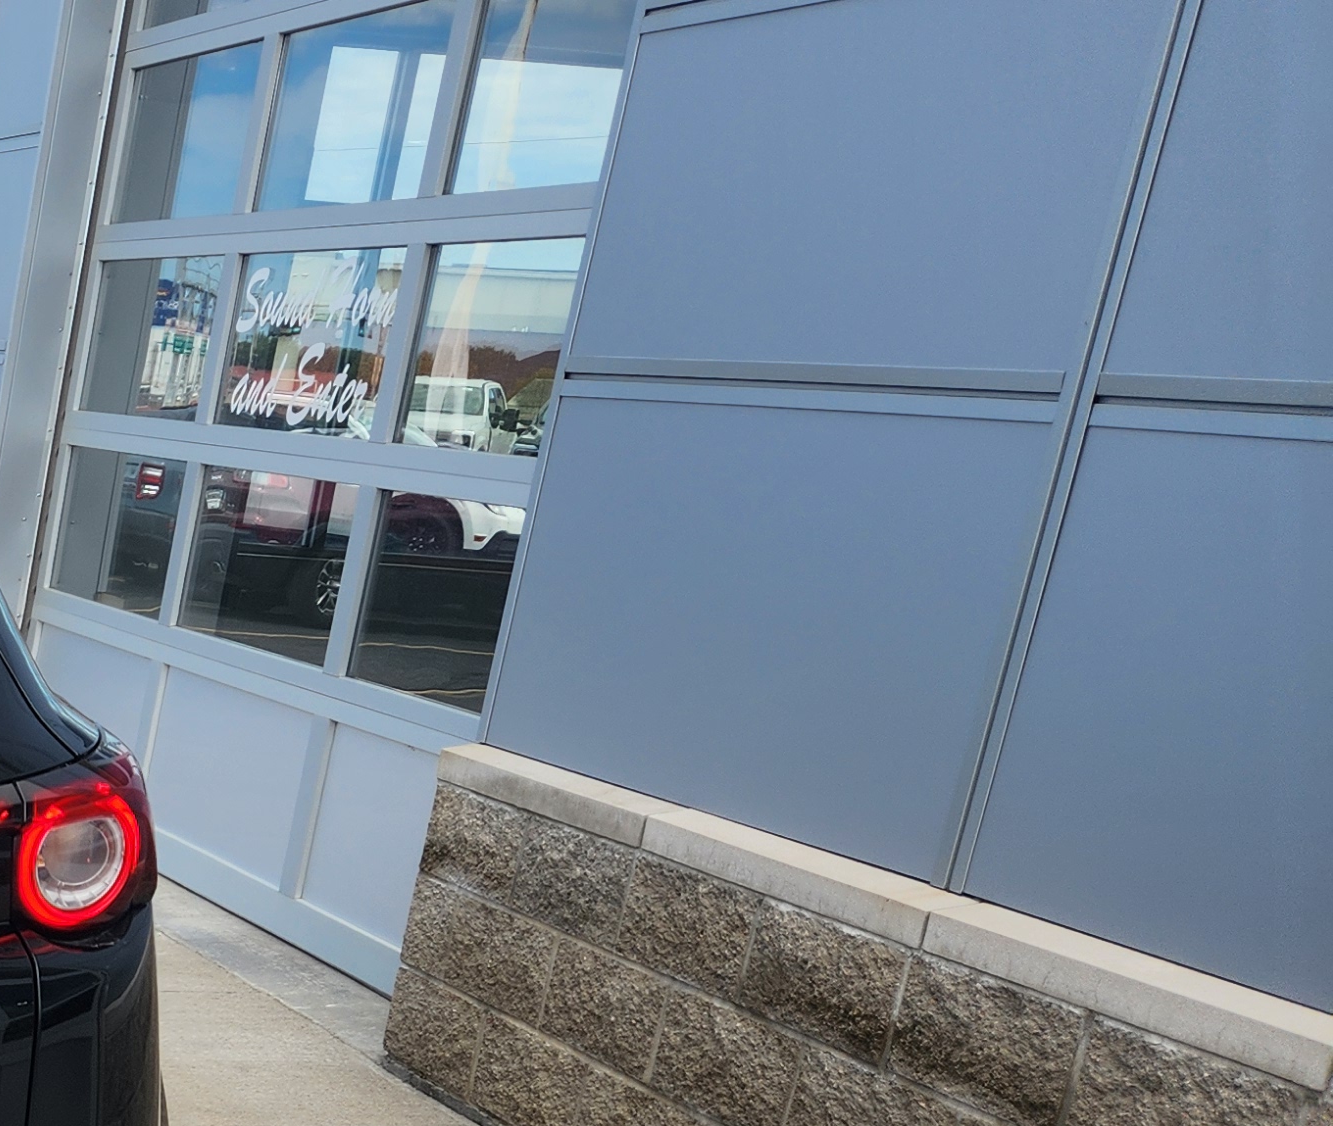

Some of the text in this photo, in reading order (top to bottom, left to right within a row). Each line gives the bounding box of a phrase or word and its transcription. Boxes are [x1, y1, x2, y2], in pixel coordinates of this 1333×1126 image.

[236, 255, 398, 338] Sound Horn
[229, 342, 369, 426] and Enter
